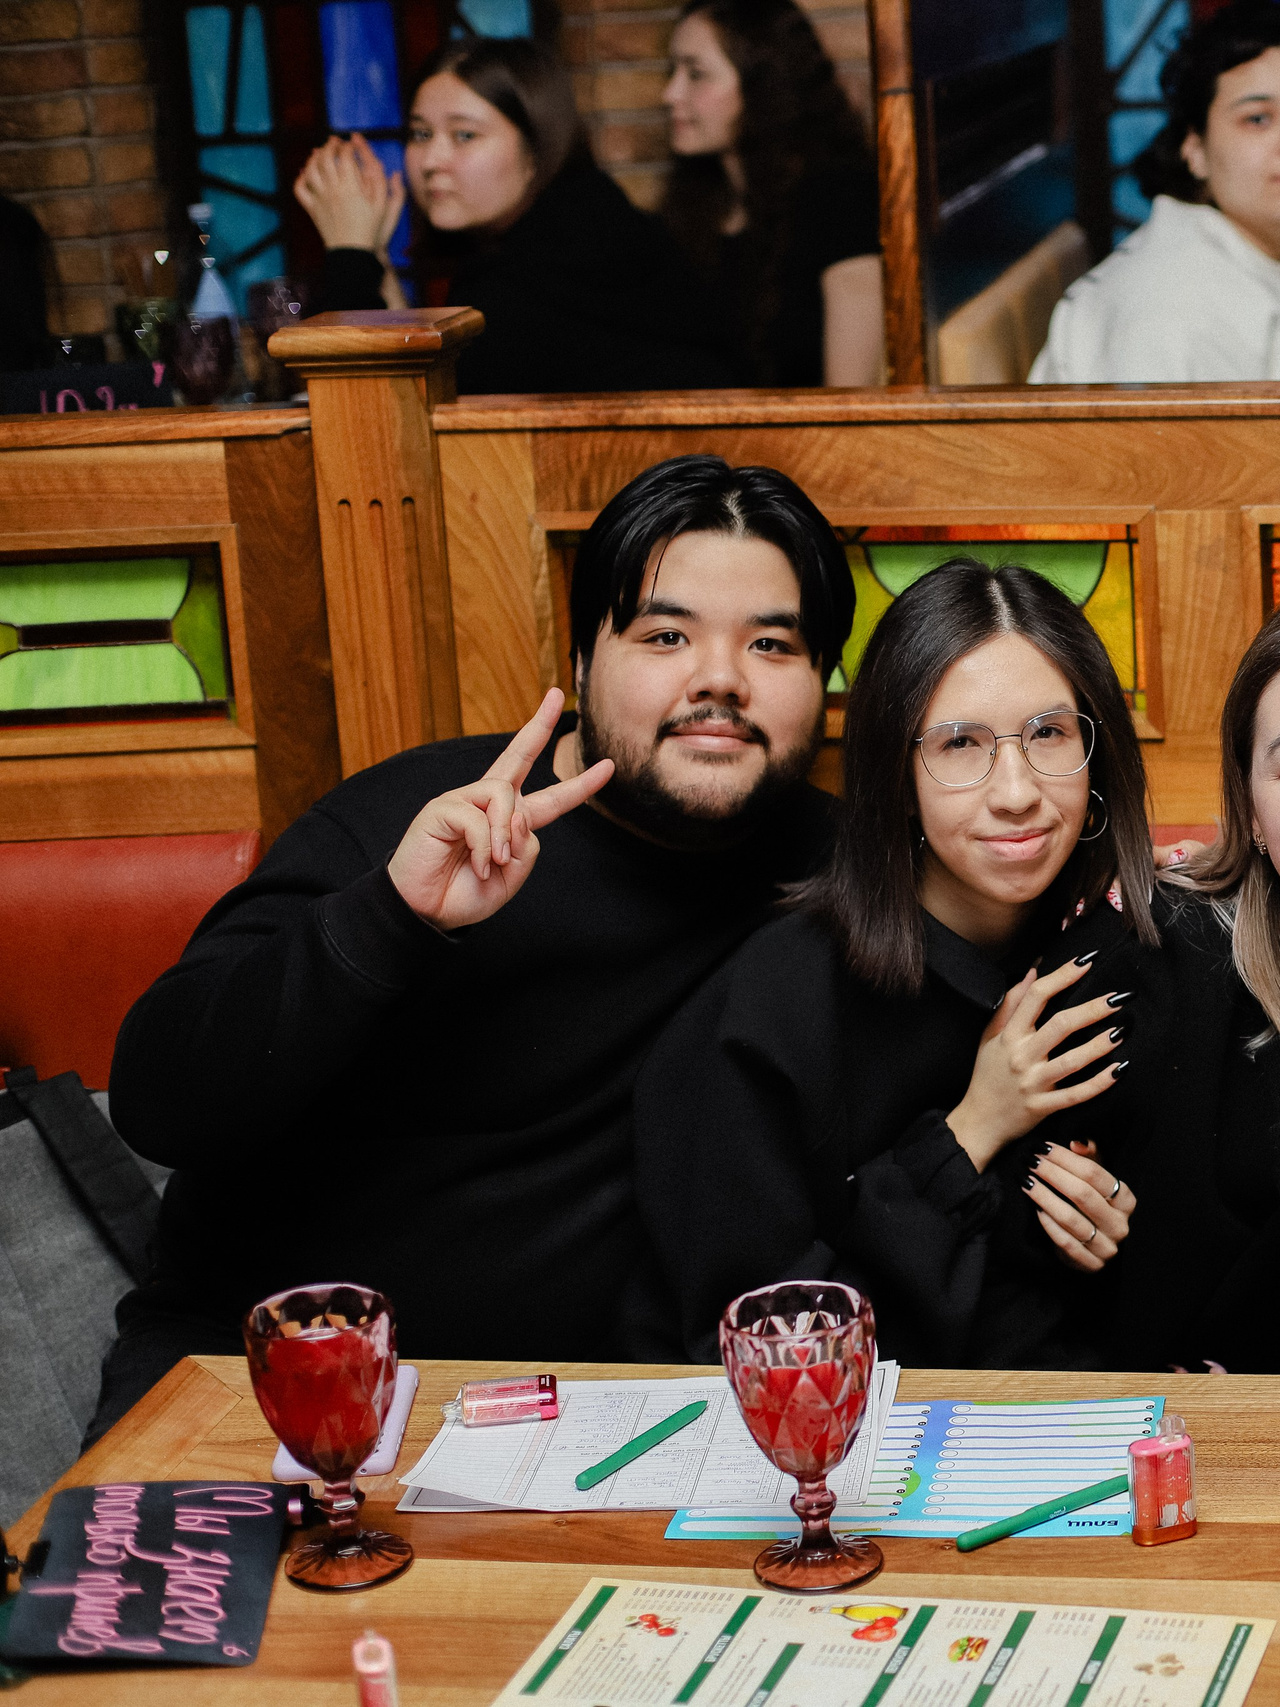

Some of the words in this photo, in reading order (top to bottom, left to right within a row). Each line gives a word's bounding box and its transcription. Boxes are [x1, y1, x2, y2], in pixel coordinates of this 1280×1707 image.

[83, 1485, 146, 1567] только
[172, 1486, 274, 1536] Мы
[123, 1533, 232, 1644] знаем
